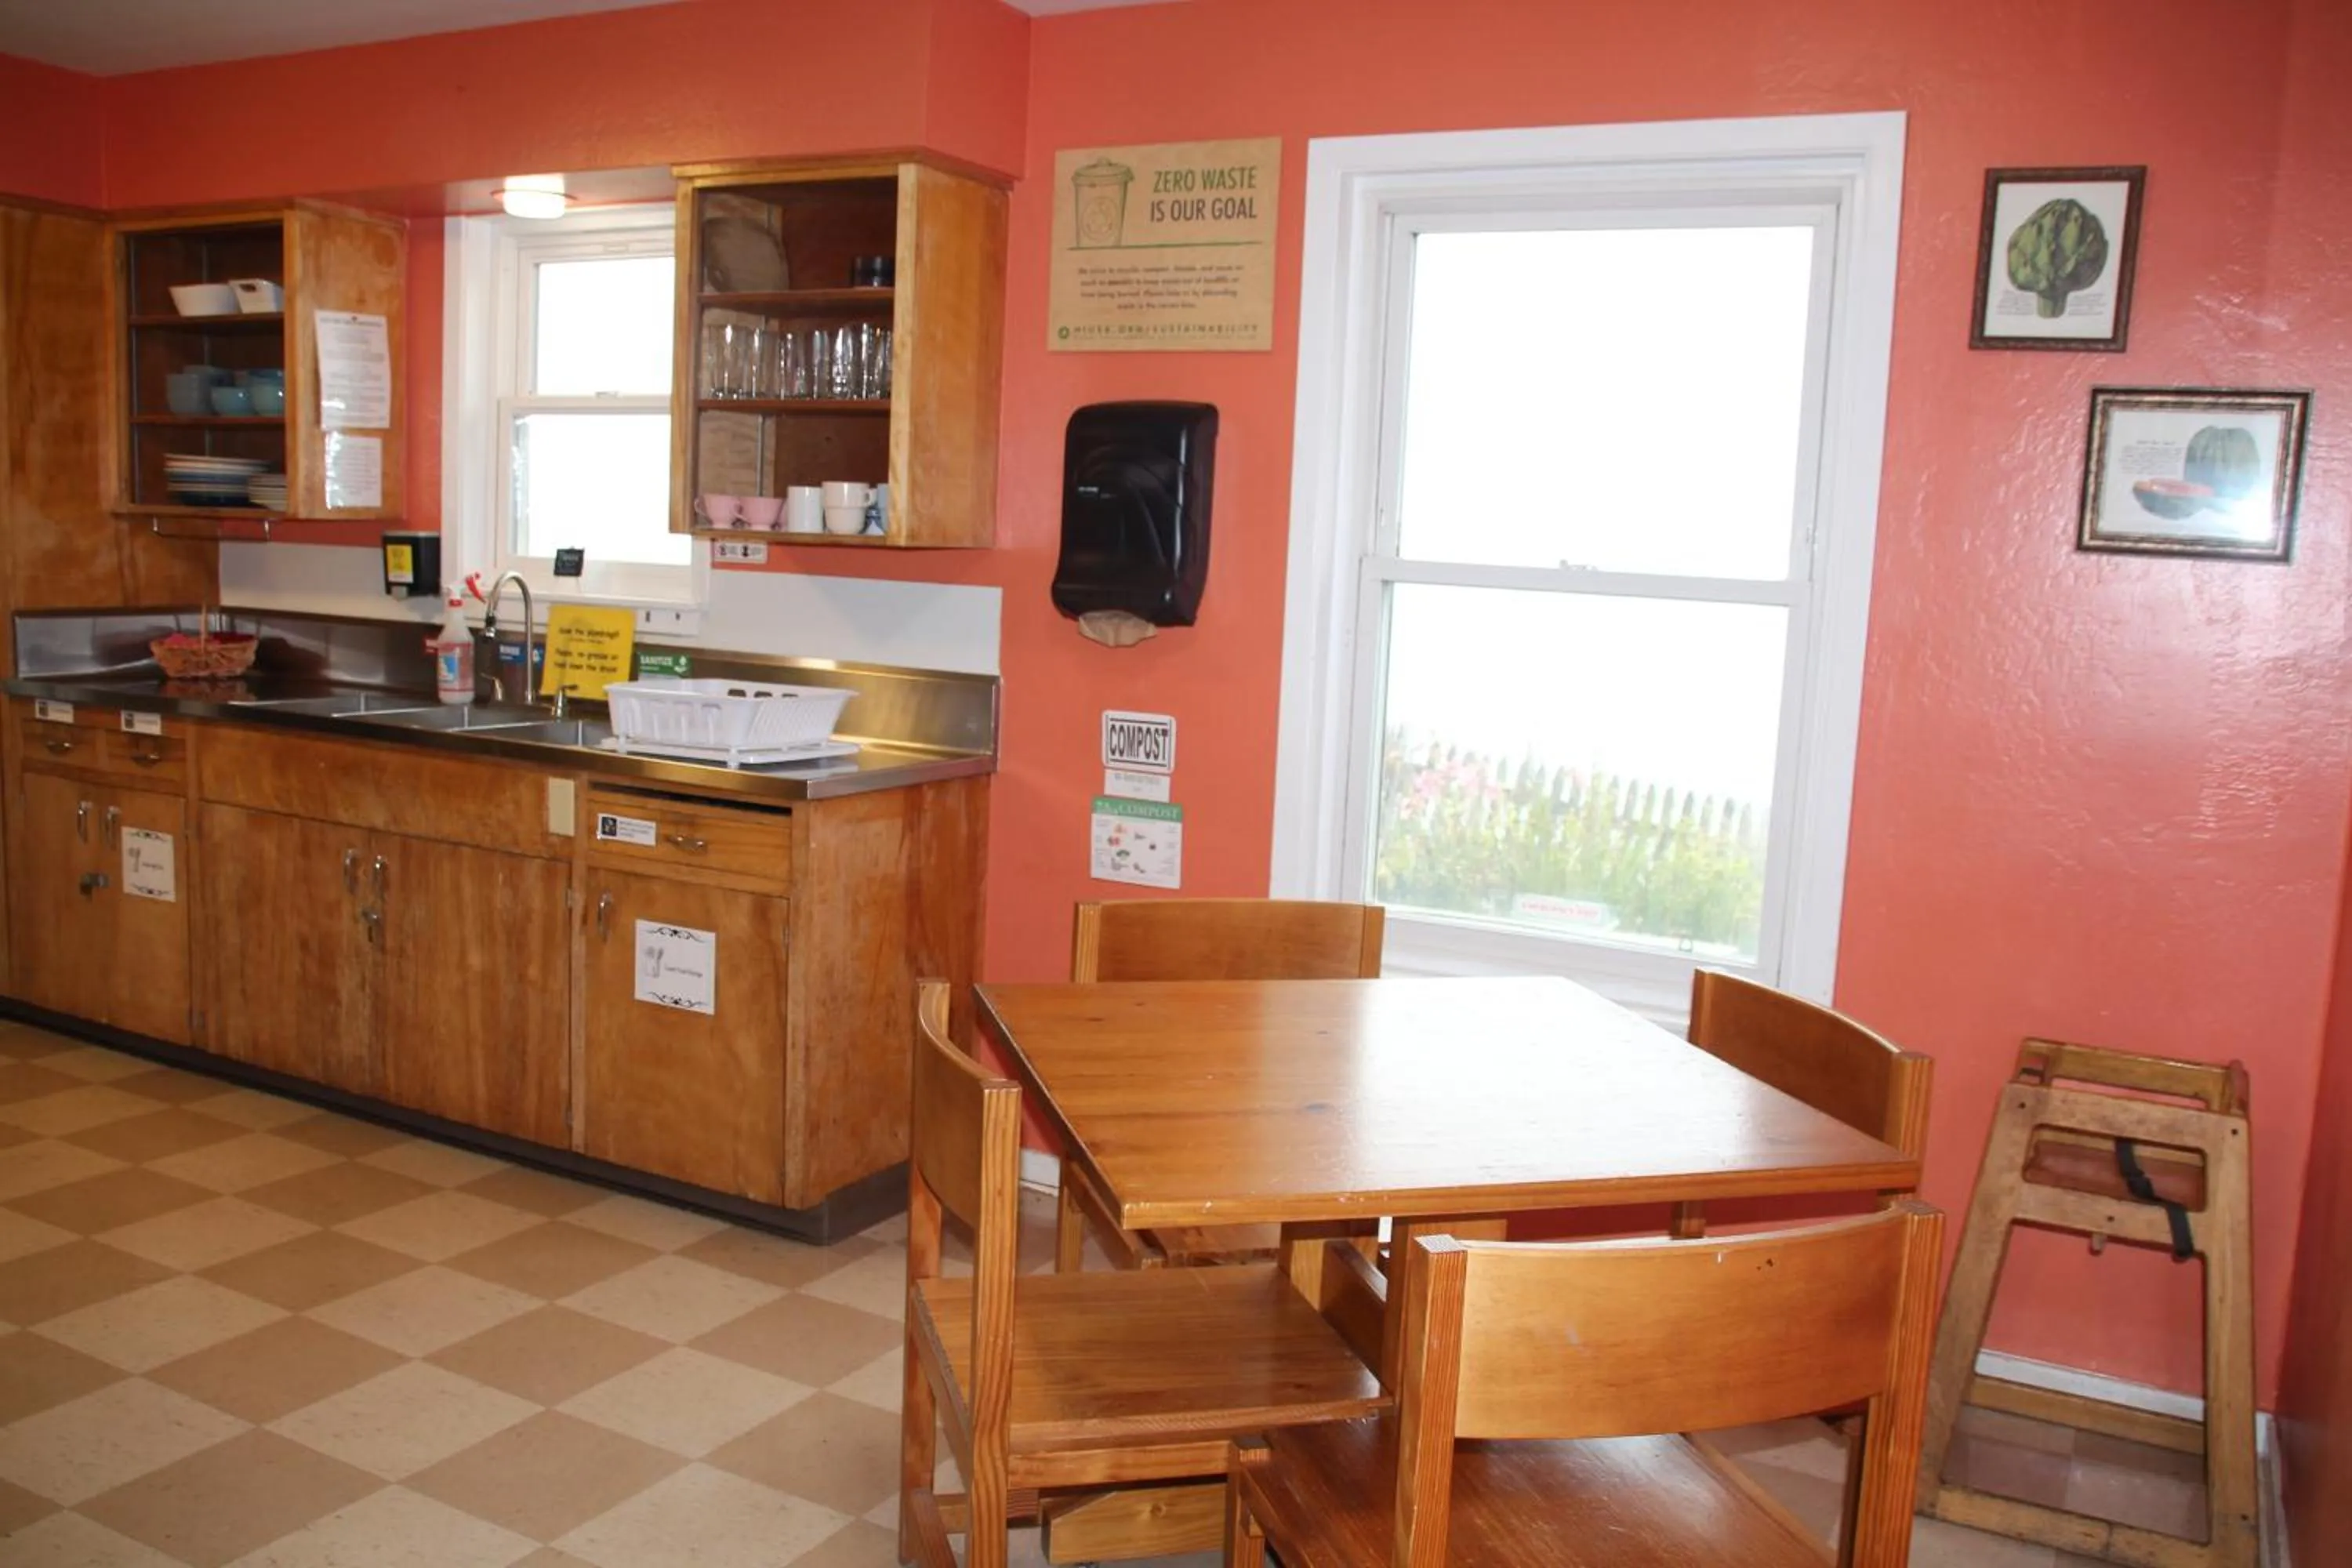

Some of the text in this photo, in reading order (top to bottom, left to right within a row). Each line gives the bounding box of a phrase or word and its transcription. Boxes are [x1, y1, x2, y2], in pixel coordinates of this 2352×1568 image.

[1153, 165, 1258, 194] ZERO WASTE
[1150, 197, 1258, 223] IS OUR GOAL
[1109, 724, 1169, 761] COMPOST
[1119, 804, 1178, 819] COMPOST
